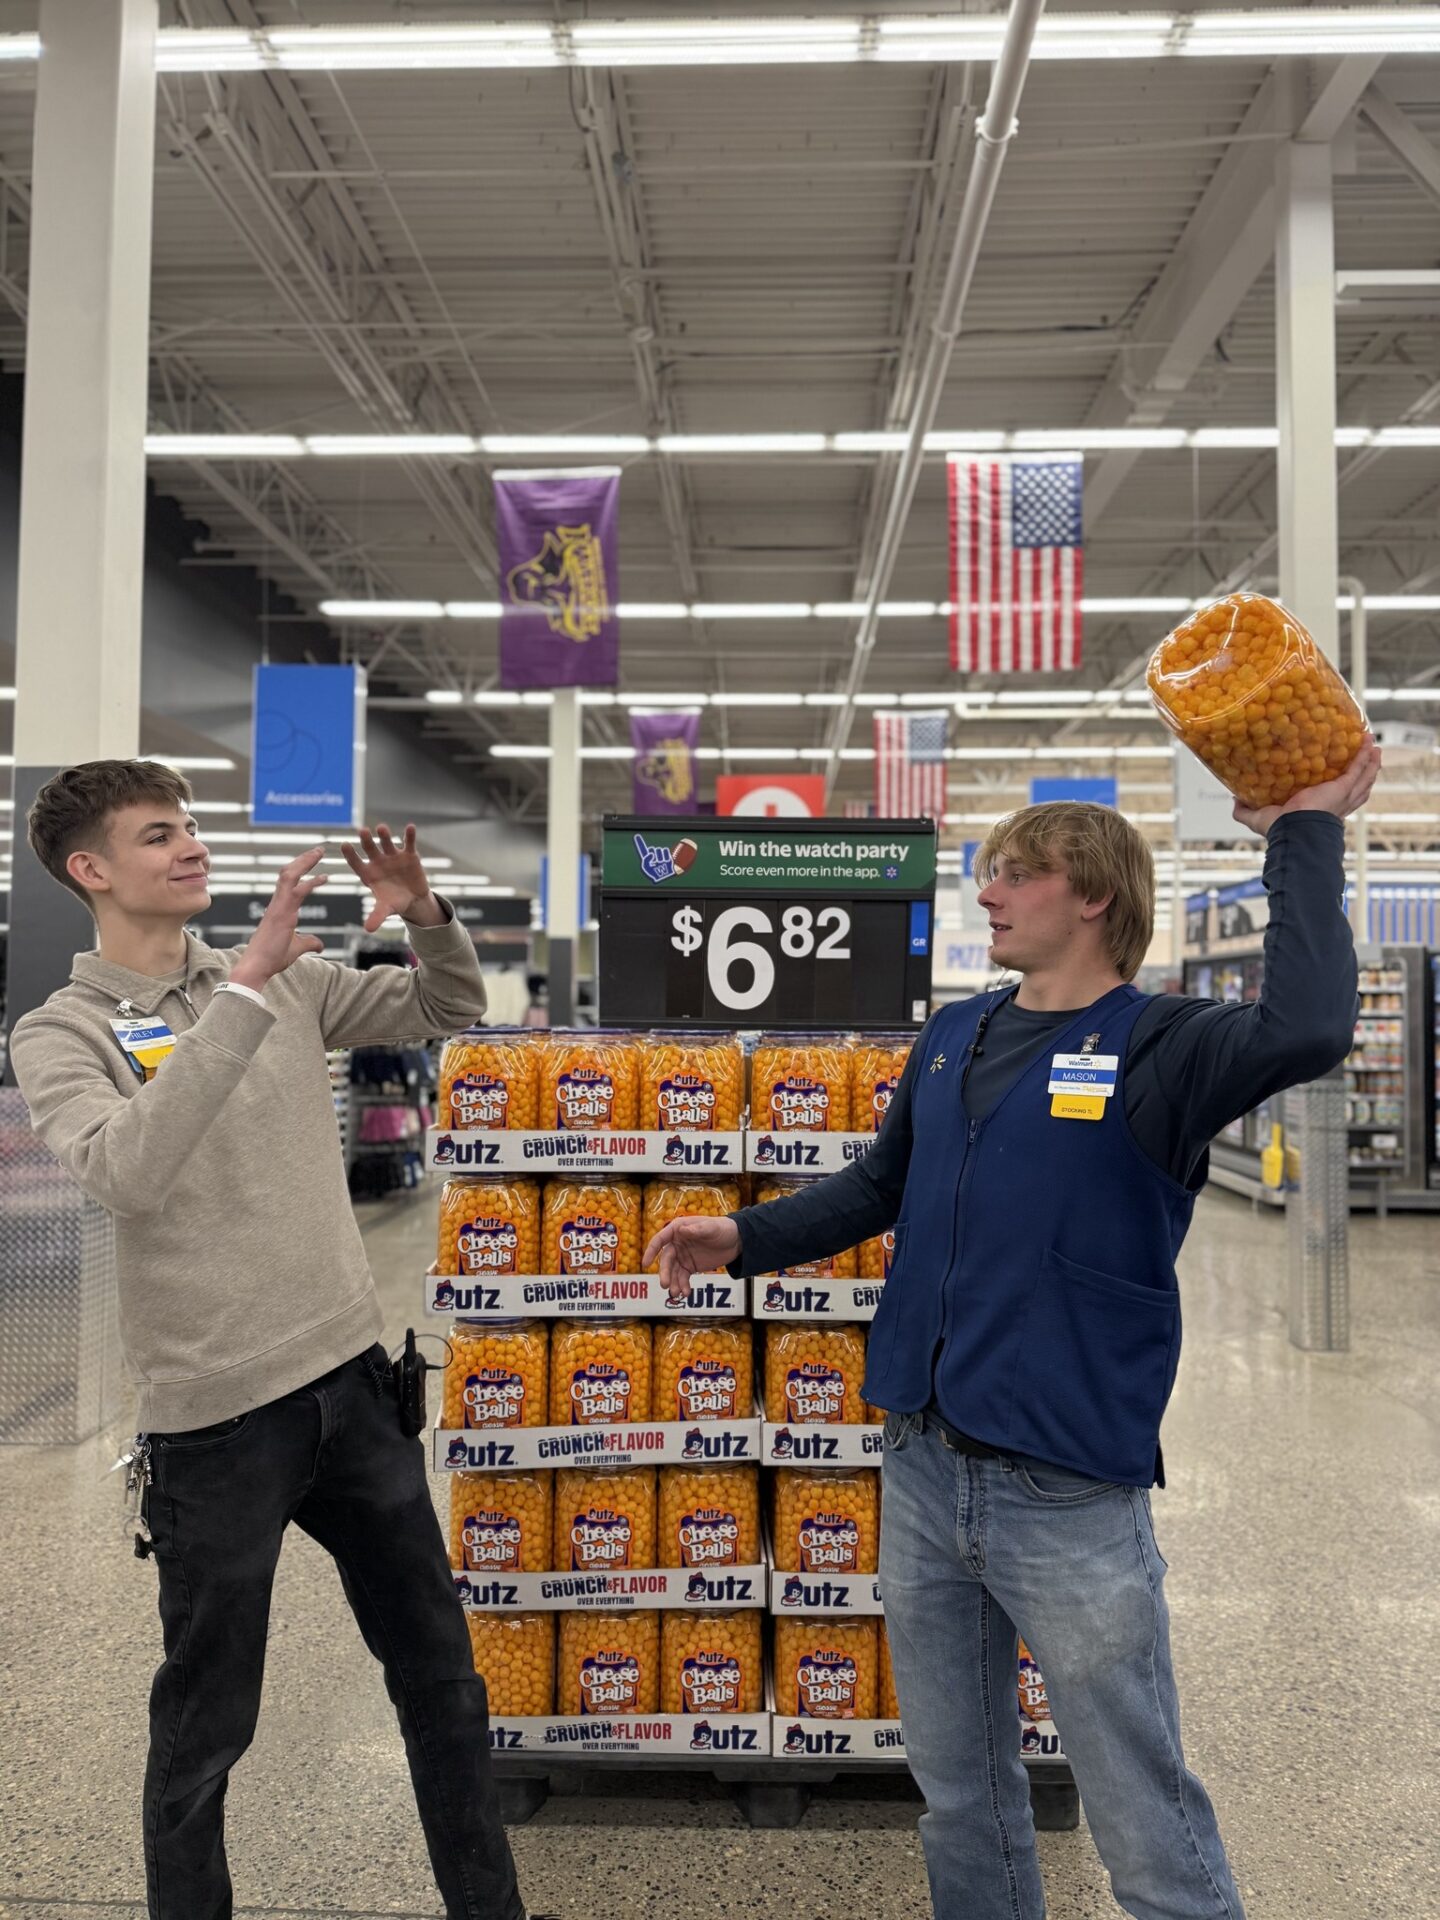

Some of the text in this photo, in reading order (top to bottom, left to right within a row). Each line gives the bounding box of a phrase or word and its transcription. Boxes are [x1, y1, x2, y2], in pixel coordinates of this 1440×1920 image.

[265, 790, 344, 806] Accessories
[719, 841, 909, 861] Win the watch party
[720, 865, 881, 880] Score even more in the app.
[912, 938, 926, 947] GR
[946, 943, 986, 970] PIZZ
[1062, 1072, 1097, 1081] MASON
[450, 1088, 508, 1107] Cheese
[556, 1082, 614, 1103] Cheese
[657, 1089, 715, 1110] Cheese
[770, 1091, 829, 1112] Cheese
[461, 1105, 502, 1124] Balls
[566, 1100, 608, 1118] Balls
[668, 1107, 709, 1125] Balls
[781, 1110, 822, 1127] Balls
[558, 1158, 613, 1167] OVER EVERYTHING
[457, 1232, 517, 1253] Cheese
[560, 1231, 618, 1251] Cheese
[468, 1250, 511, 1269] Balls
[569, 1249, 612, 1267] Balls
[559, 1302, 615, 1311] OVER EVERYTHING
[463, 1385, 524, 1406] Cheese
[570, 1380, 631, 1401] Cheese
[677, 1376, 736, 1397] Cheese
[785, 1379, 845, 1399] Cheese
[474, 1403, 518, 1422] Balls
[581, 1398, 624, 1417] Balls
[688, 1394, 730, 1413] Balls
[796, 1398, 839, 1416] Balls
[574, 1454, 631, 1465] OVER EVERYTHING
[461, 1527, 521, 1547] Cheese
[570, 1525, 631, 1545] Cheese
[679, 1524, 738, 1545] Cheese
[799, 1529, 858, 1549] Cheese
[472, 1544, 515, 1563] Balls
[581, 1543, 624, 1561] Balls
[690, 1542, 732, 1562] Balls
[810, 1548, 852, 1565] Balls
[577, 1596, 634, 1605] OVER EVERYTHING
[579, 1667, 640, 1688] Cheese
[681, 1668, 741, 1688] Cheese
[796, 1666, 857, 1686] Cheese
[590, 1685, 633, 1704] Balls
[692, 1686, 734, 1705] Balls
[808, 1685, 851, 1702] Balls
[582, 1742, 639, 1751] OVER EVERYTHING
